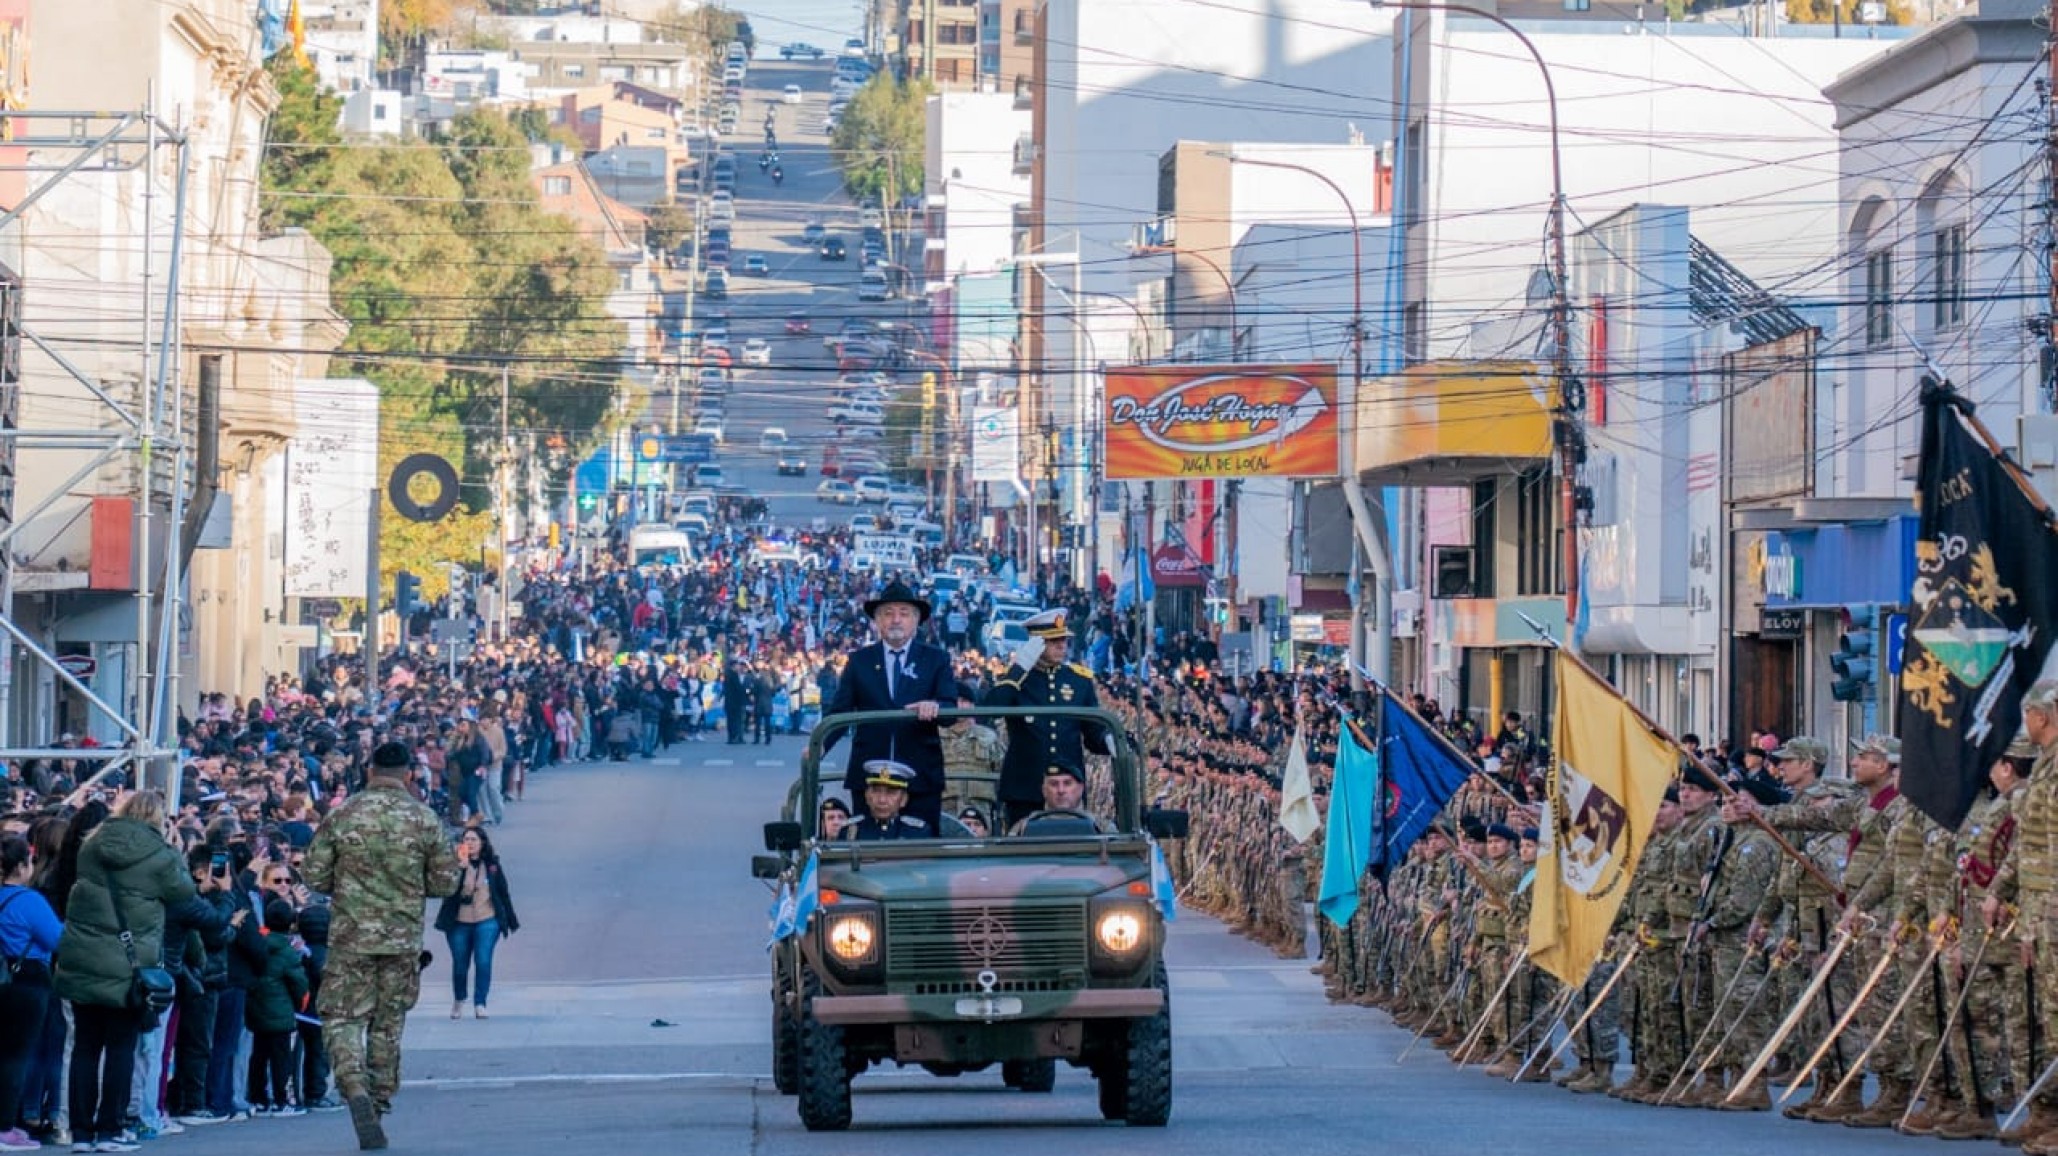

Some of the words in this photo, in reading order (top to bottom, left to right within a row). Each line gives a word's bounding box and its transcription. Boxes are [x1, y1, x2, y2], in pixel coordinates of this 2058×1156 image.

[1111, 395, 1159, 425] Don
[1159, 393, 1213, 435] José
[1216, 457, 1231, 471] DE
[1235, 456, 1271, 471] LOCAL
